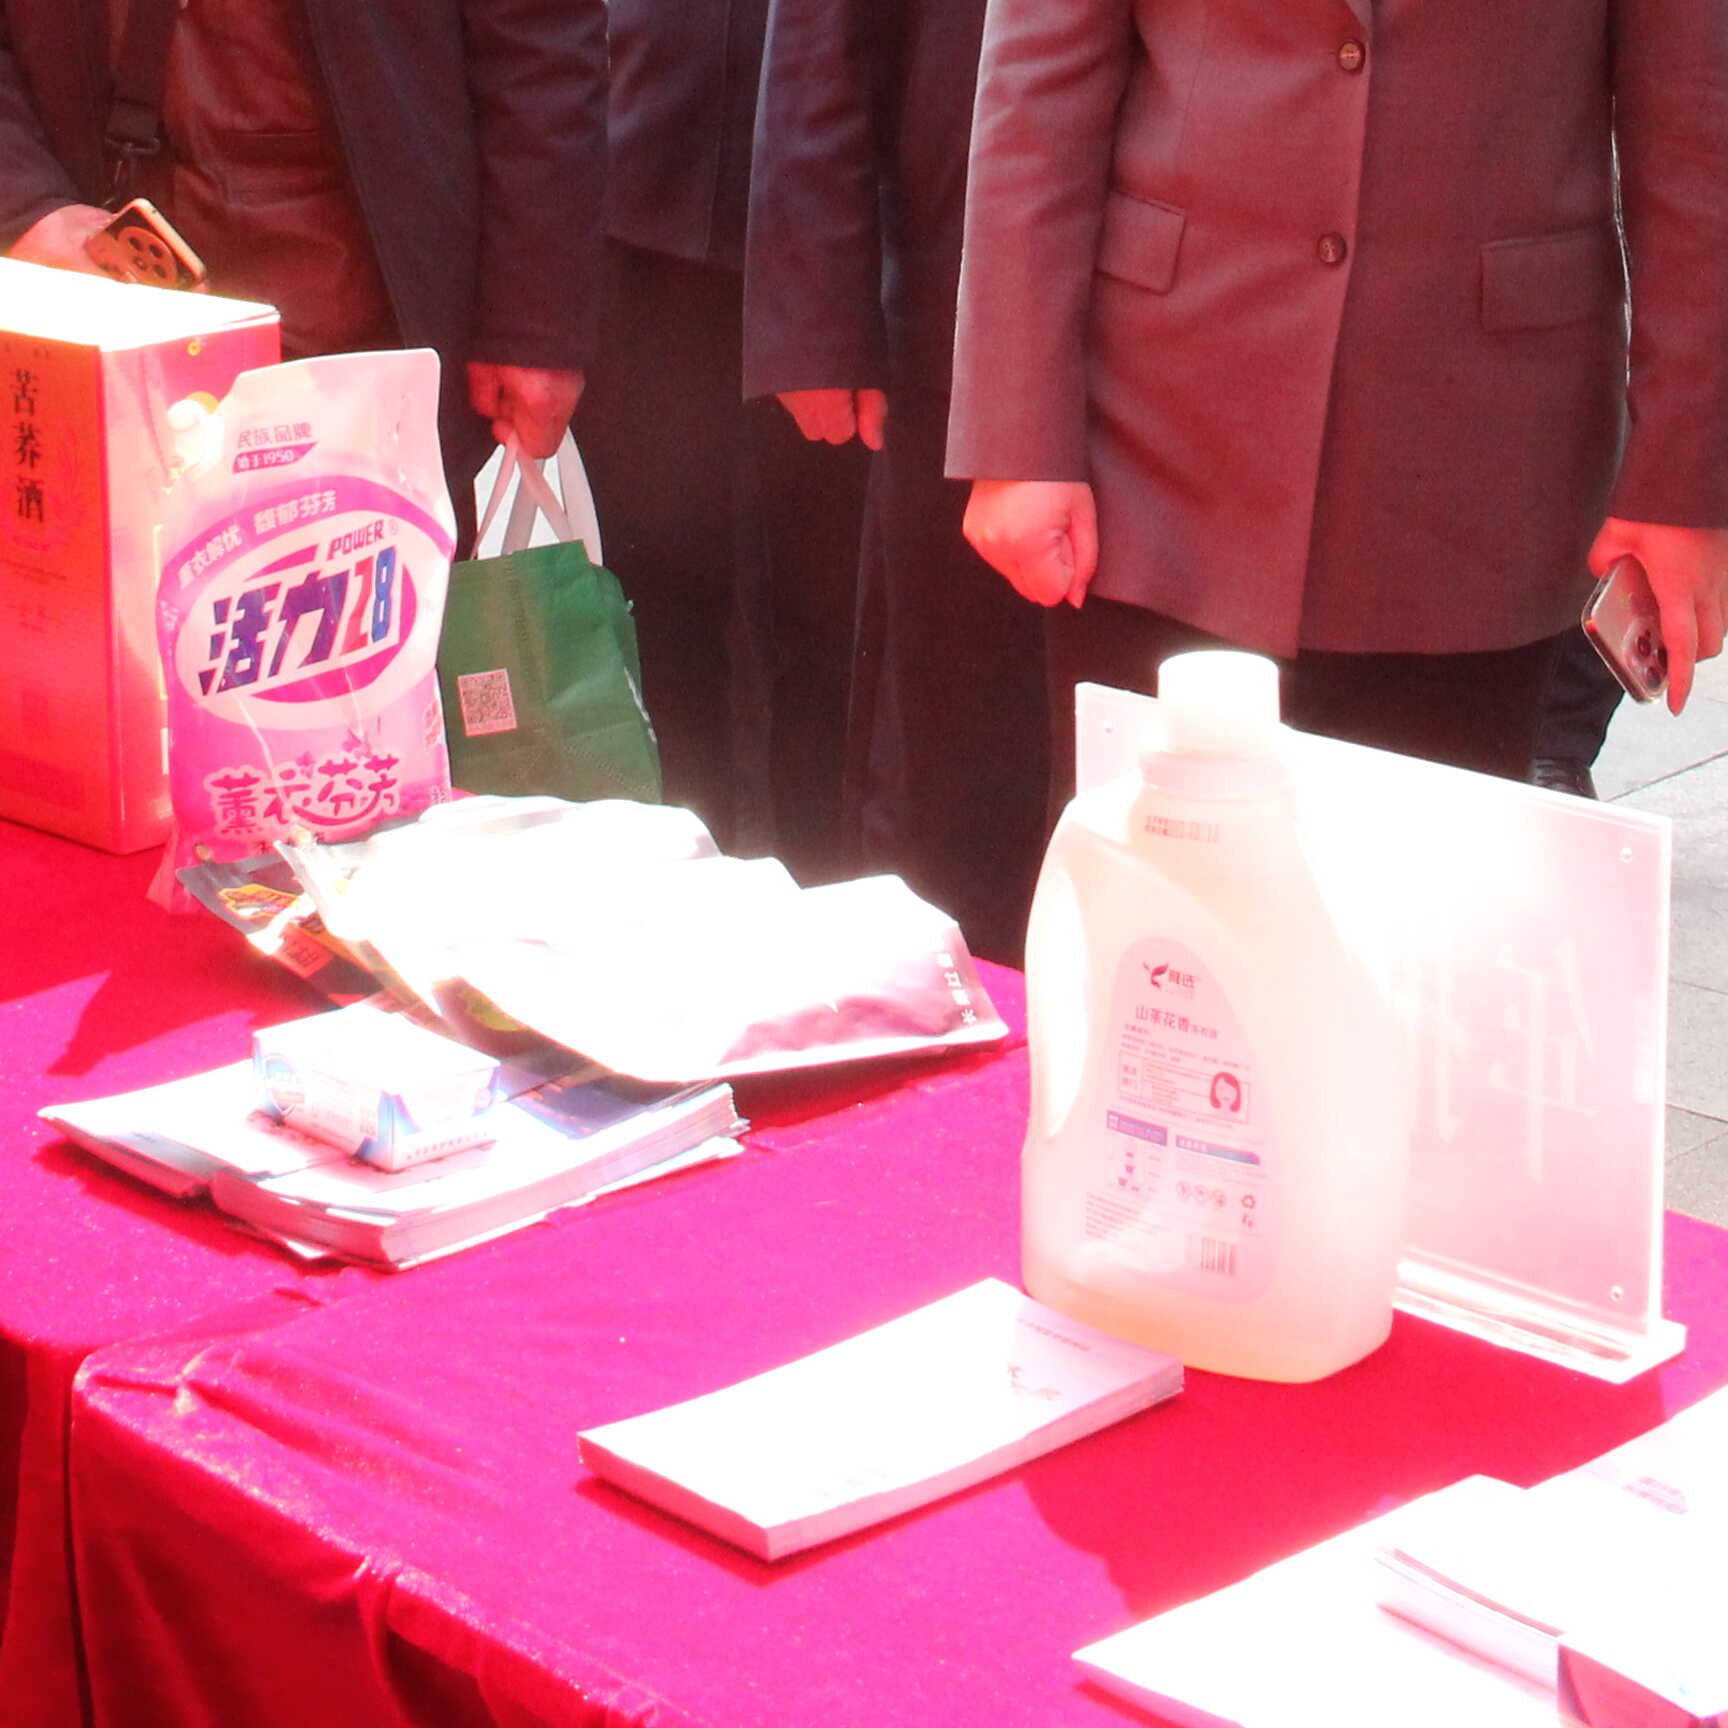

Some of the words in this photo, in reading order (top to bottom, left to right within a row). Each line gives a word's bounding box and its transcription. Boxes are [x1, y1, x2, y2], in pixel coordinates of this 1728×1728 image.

[13, 368, 45, 523] 苦荞酒
[327, 519, 385, 561] POWER
[198, 545, 396, 696] 活力28
